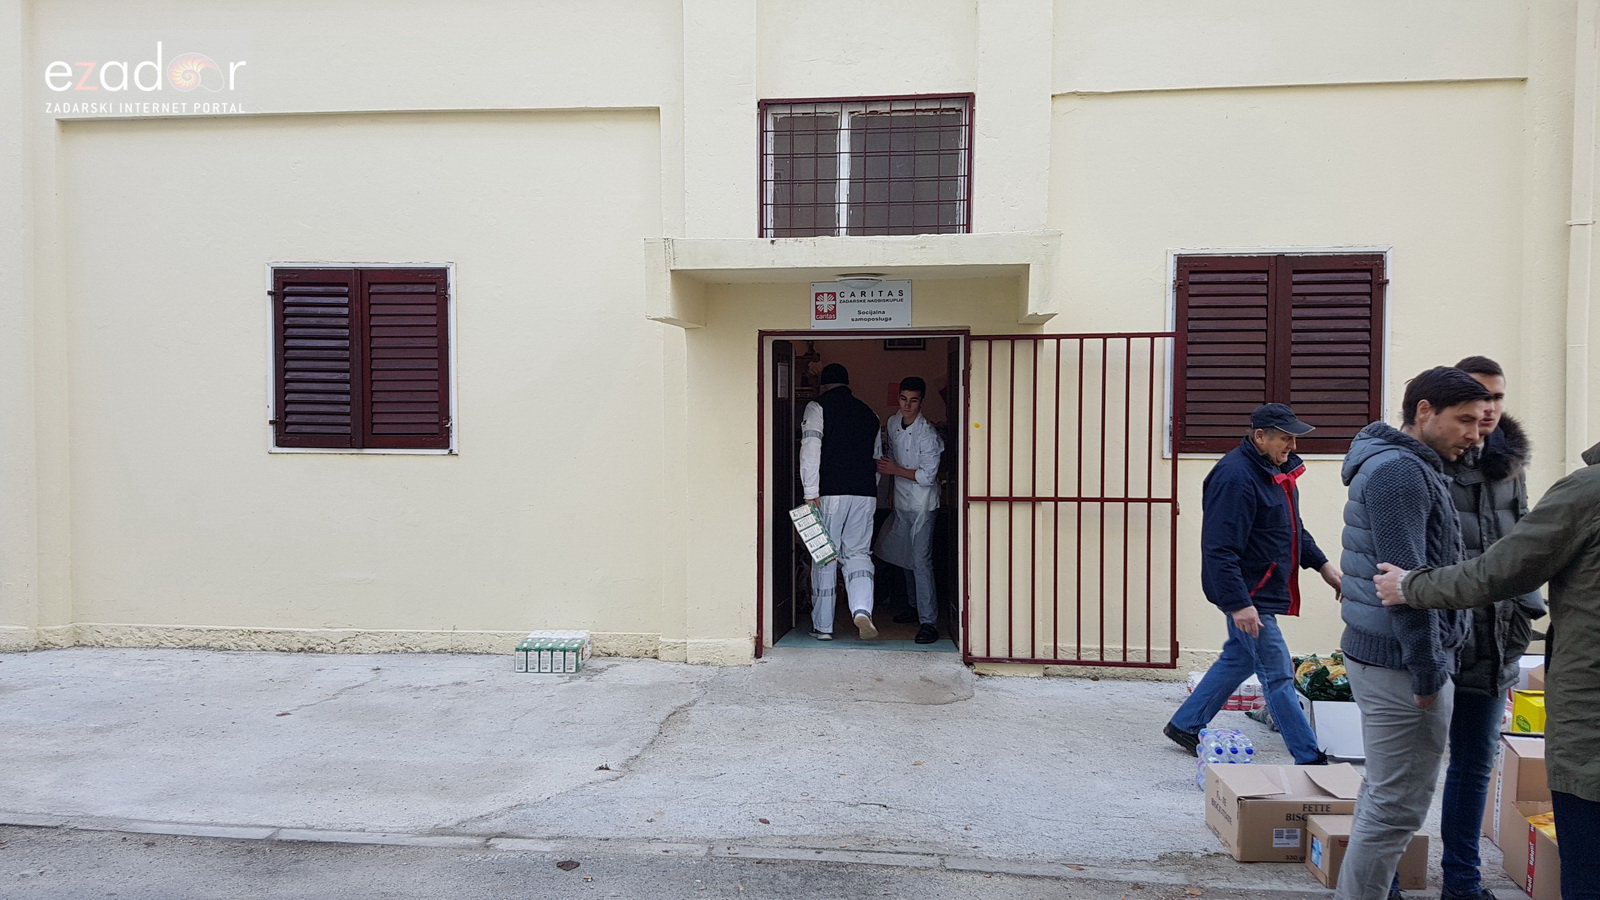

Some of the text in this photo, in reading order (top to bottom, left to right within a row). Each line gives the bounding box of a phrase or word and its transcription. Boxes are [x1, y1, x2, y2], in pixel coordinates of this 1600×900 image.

[839, 290, 904, 299] CARITAS
[851, 317, 893, 325] samoposluga
[1302, 804, 1331, 812] FETTE
[1285, 813, 1308, 822] BISC
